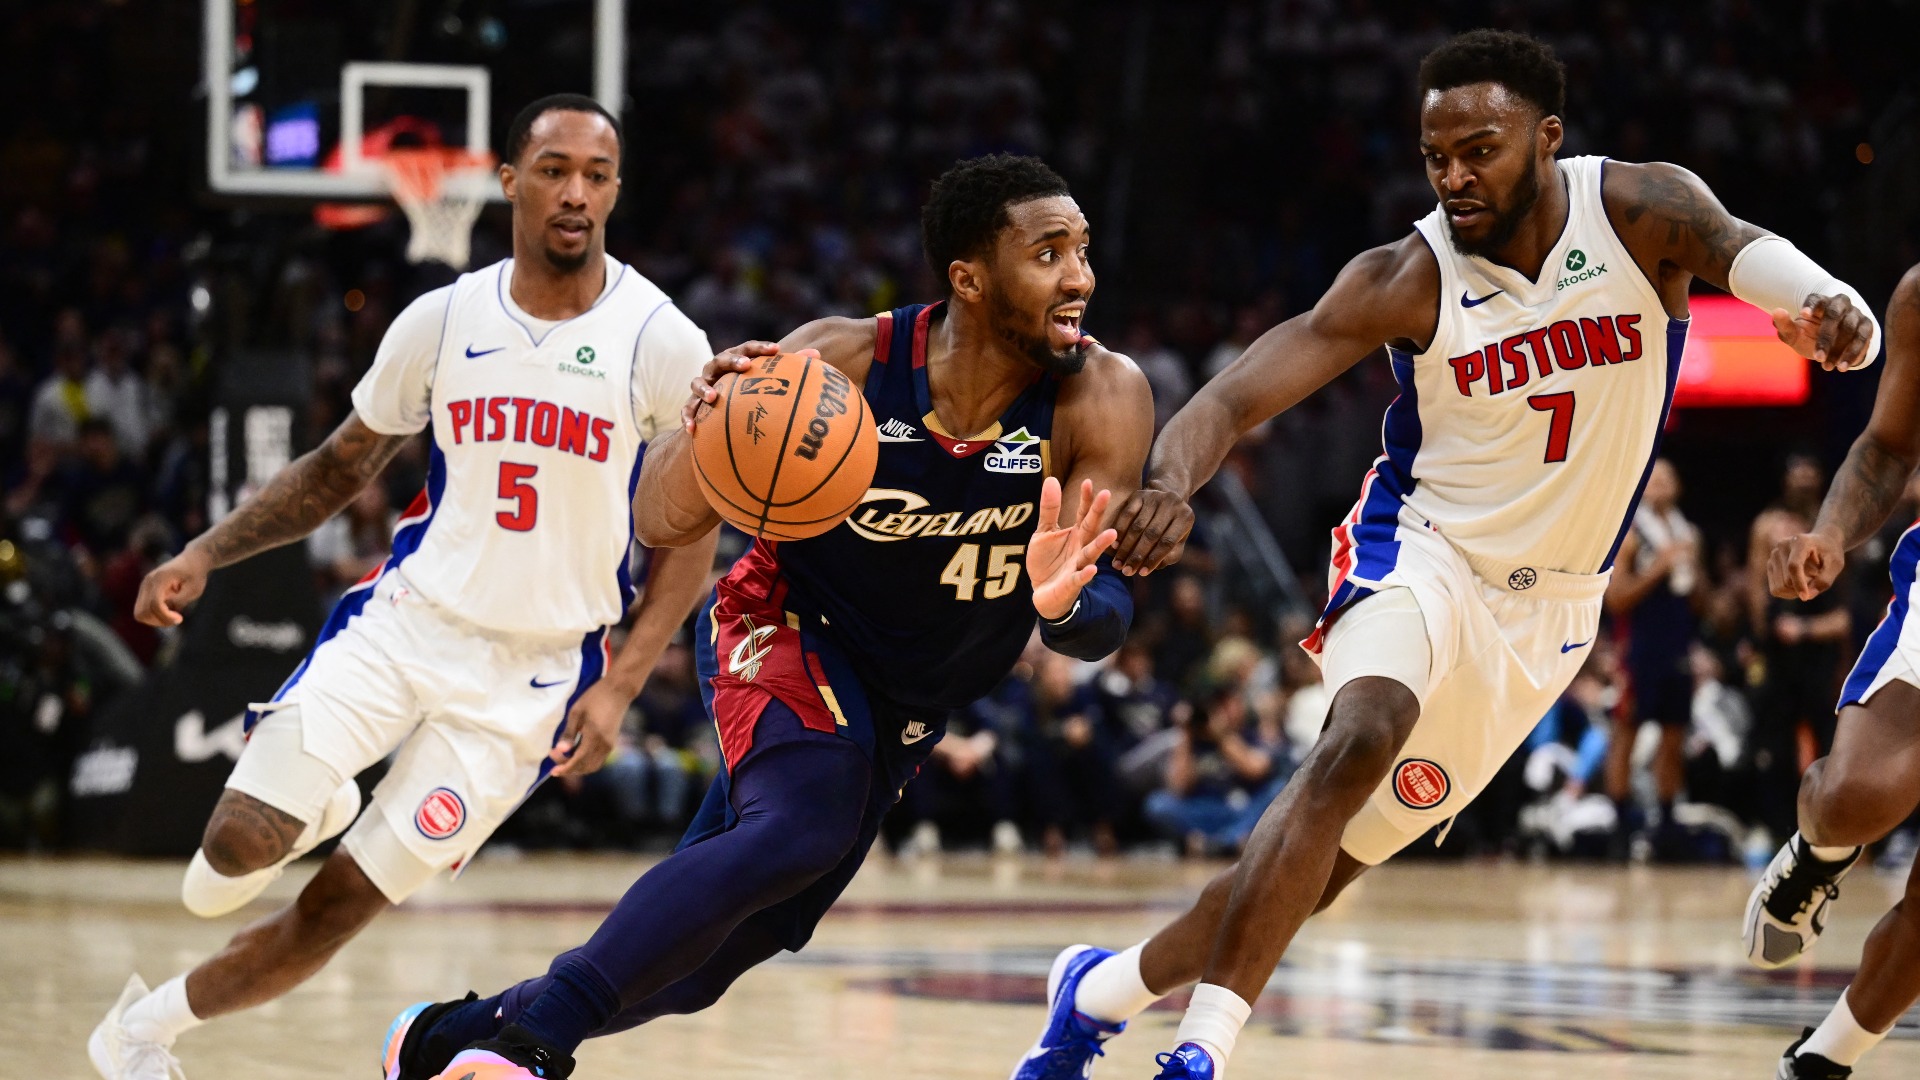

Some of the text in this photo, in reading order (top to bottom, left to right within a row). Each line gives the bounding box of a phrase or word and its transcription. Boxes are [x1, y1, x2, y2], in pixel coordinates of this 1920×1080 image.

[1448, 313, 1643, 397] PISTONS
[447, 396, 615, 463] PISTONS
[793, 365, 850, 462] Wilson
[881, 417, 917, 440] NIKE
[1527, 391, 1576, 464] 7
[986, 456, 1041, 470] CLIFFS
[496, 461, 539, 533] 5
[939, 542, 1026, 601] 45
[906, 720, 927, 738] NIKE
[1404, 769, 1431, 802] PISTONS
